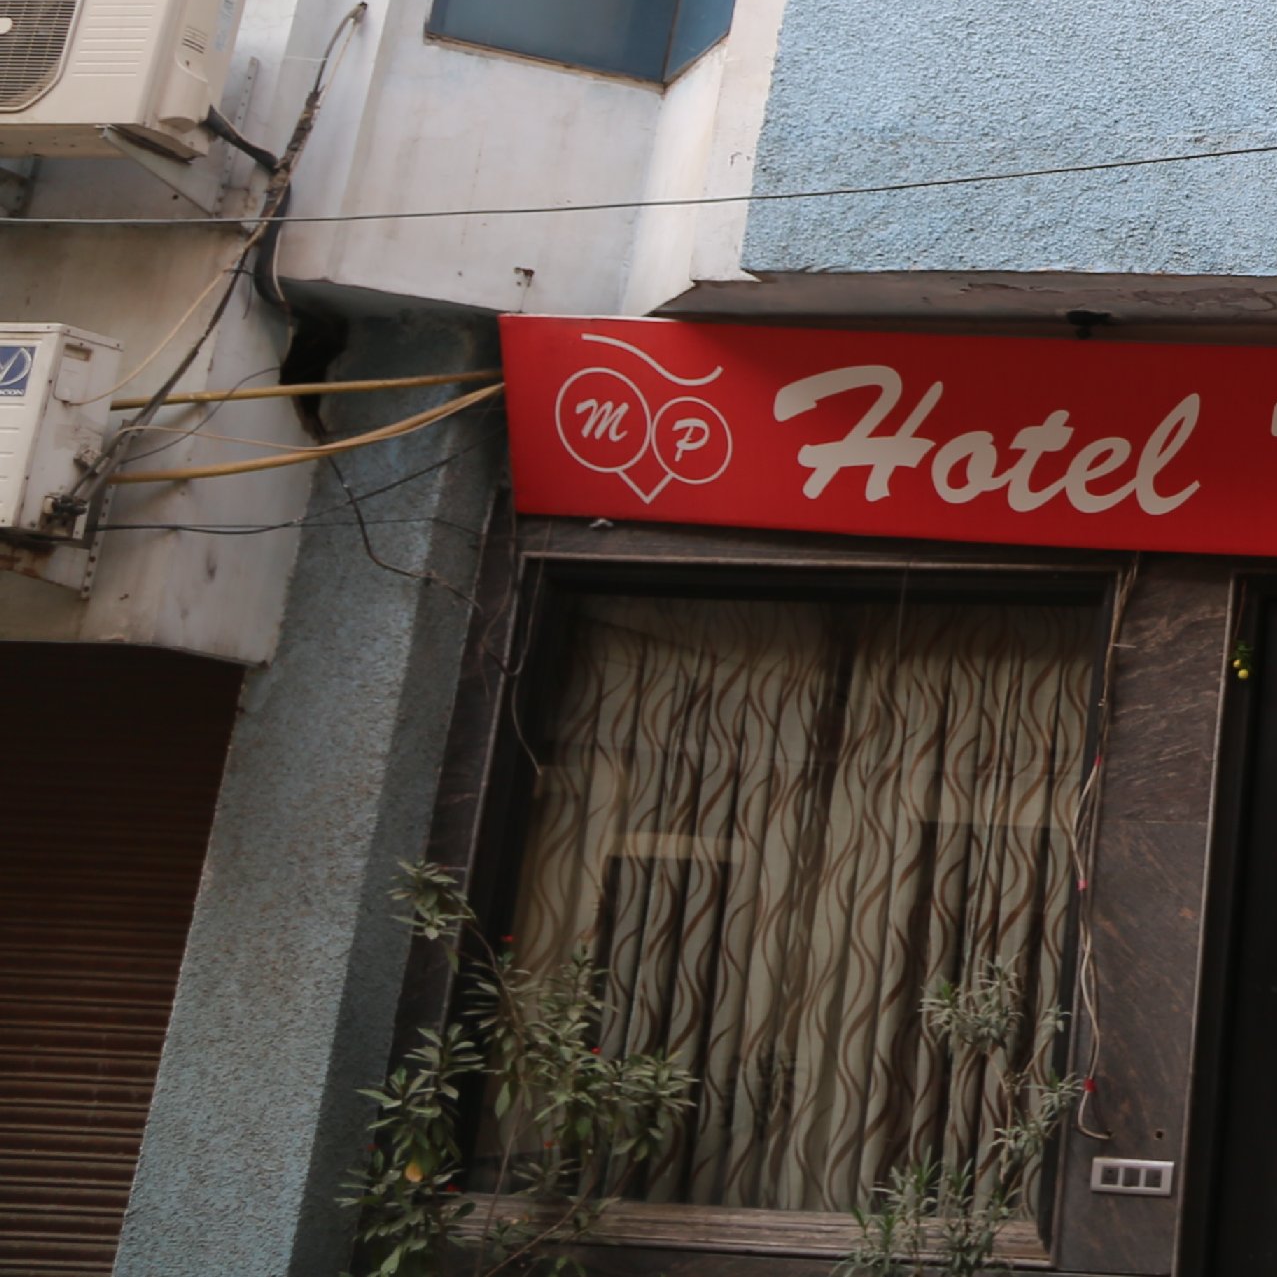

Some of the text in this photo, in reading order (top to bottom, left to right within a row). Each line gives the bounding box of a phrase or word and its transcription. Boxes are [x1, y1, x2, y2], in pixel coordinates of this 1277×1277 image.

[575, 398, 711, 462] M P
[773, 365, 1200, 515] Hotel
